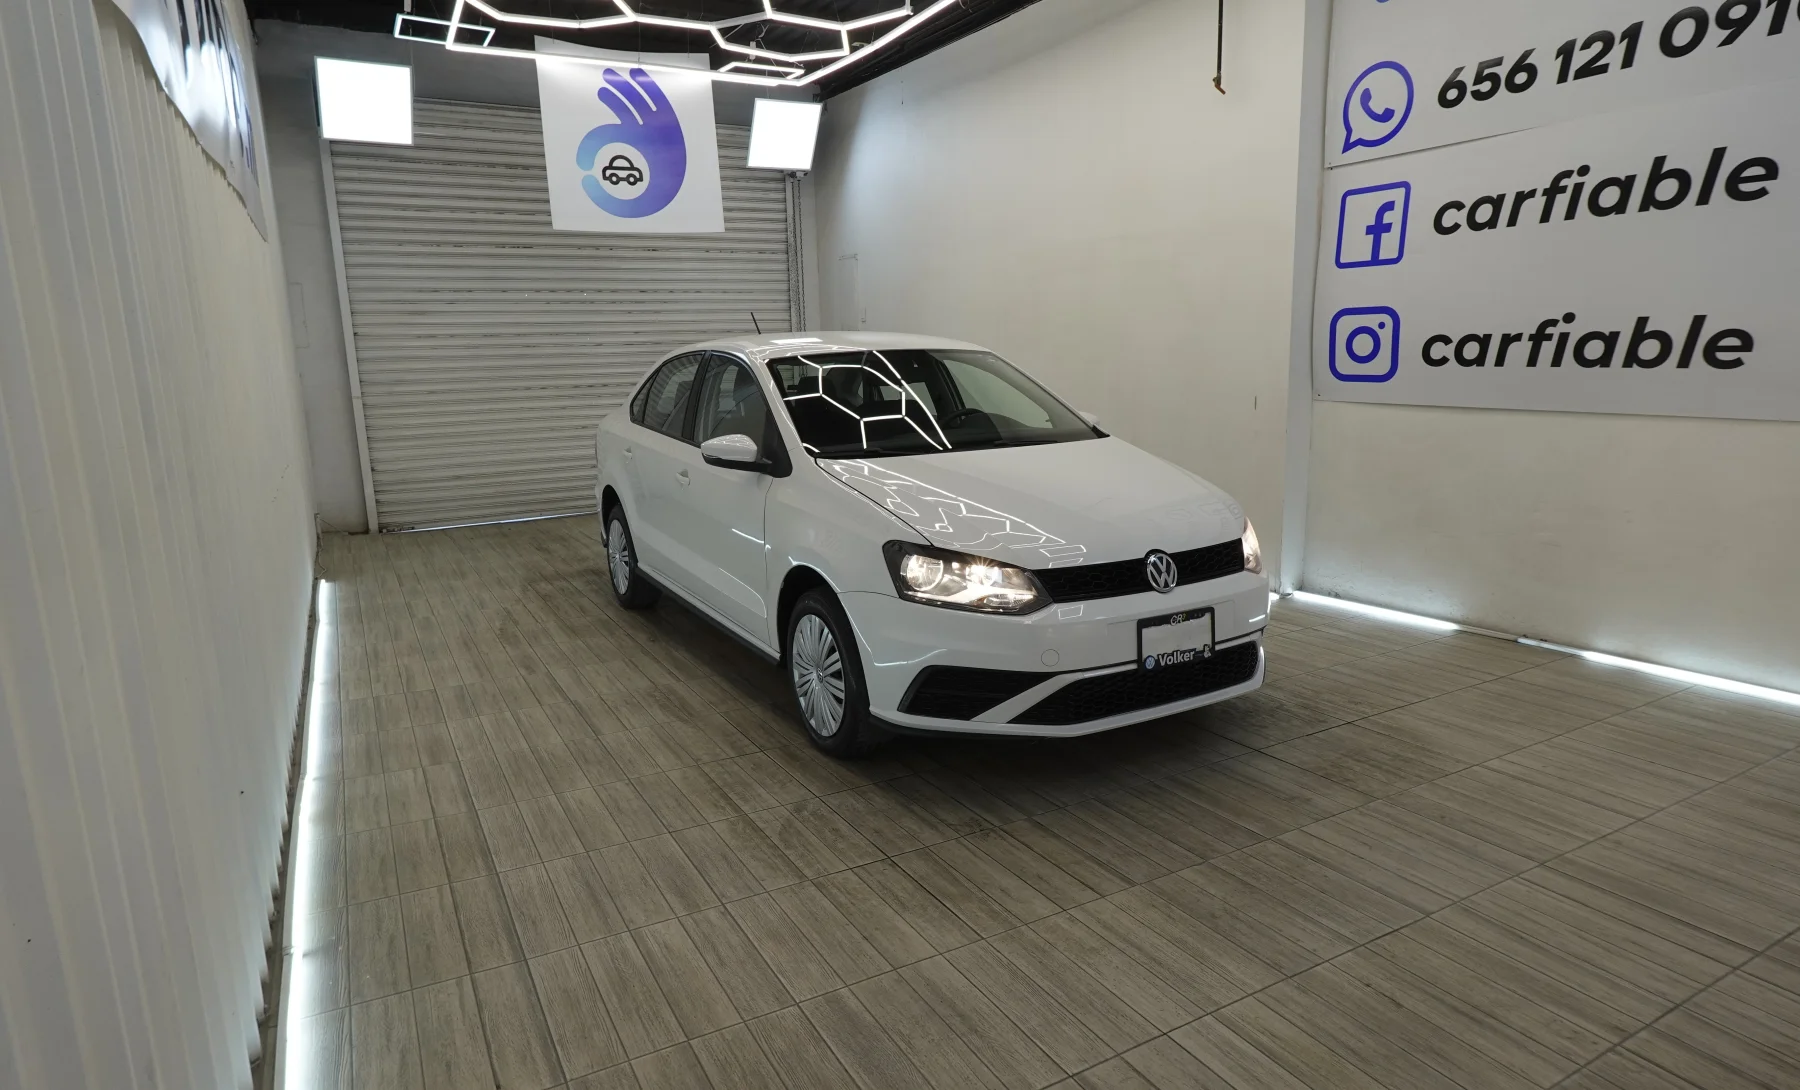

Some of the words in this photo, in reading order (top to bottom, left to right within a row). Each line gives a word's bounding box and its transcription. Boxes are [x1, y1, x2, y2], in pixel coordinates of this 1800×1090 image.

[1438, 49, 1538, 109] 656
[1554, 21, 1644, 85] 121
[1658, 0, 1800, 59] 091
[1433, 147, 1780, 236] carfiable
[1421, 312, 1755, 370] carfiable
[1158, 651, 1195, 667] Volker
